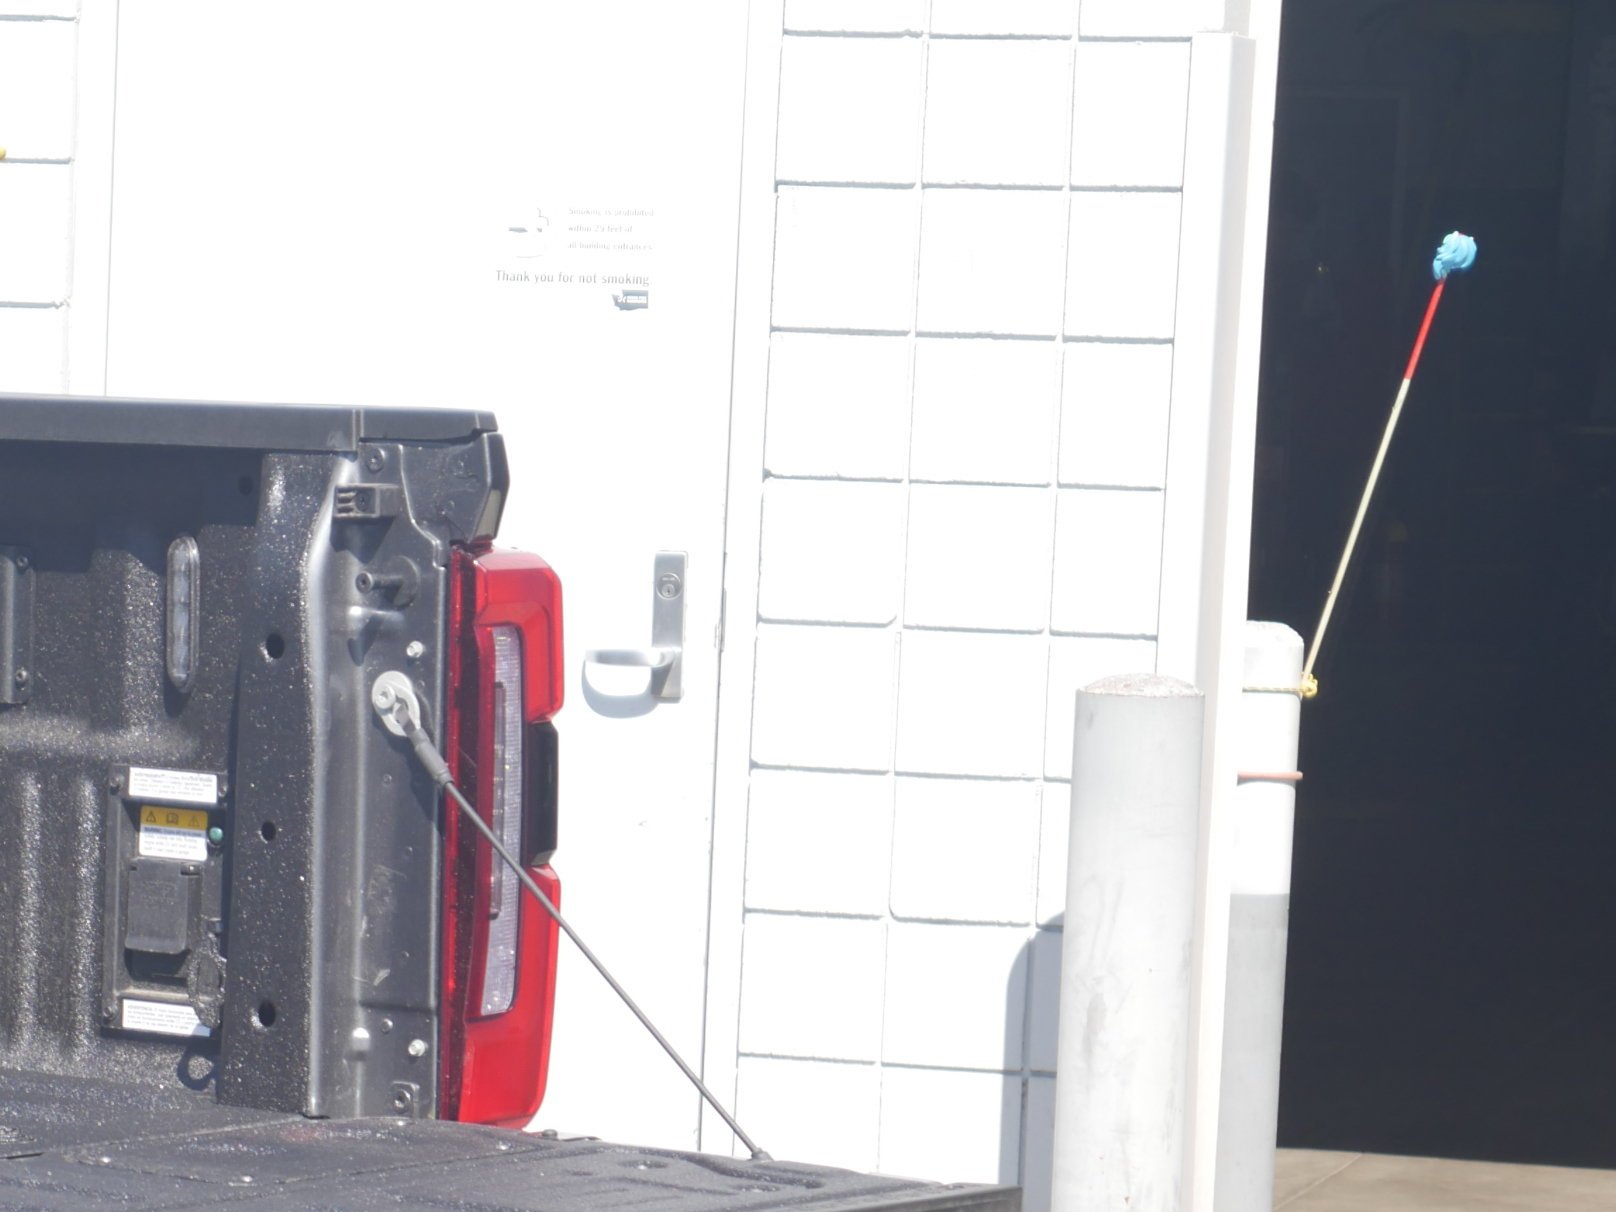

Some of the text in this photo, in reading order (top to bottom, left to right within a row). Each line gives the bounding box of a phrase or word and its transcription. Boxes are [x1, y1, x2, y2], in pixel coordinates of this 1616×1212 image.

[496, 269, 530, 283] Thank
[534, 272, 554, 284] you
[558, 271, 574, 283] for
[578, 272, 597, 284] not
